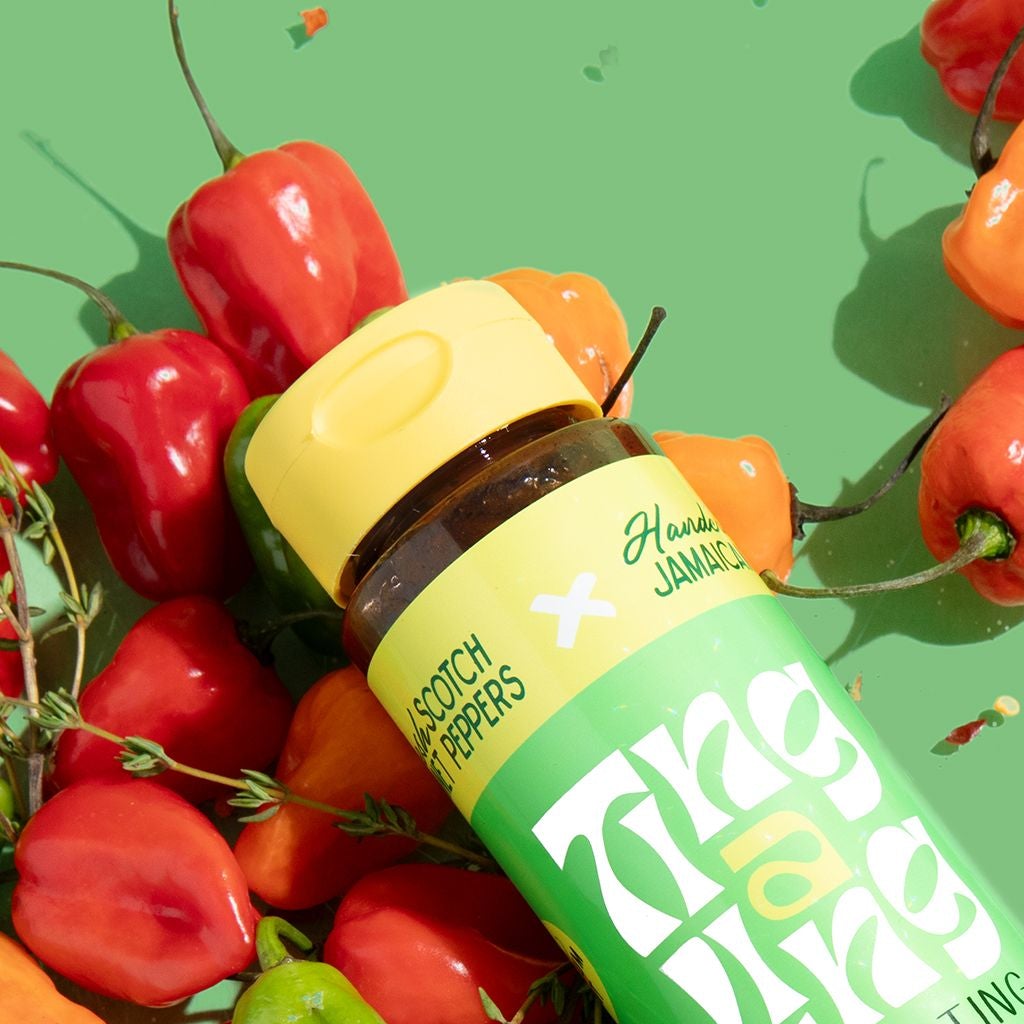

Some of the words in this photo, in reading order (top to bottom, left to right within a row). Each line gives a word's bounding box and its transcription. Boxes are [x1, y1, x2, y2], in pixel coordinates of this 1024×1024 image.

[413, 633, 492, 731] SCOTCH
[440, 665, 525, 770] PEPPERS
[719, 811, 855, 921] a
